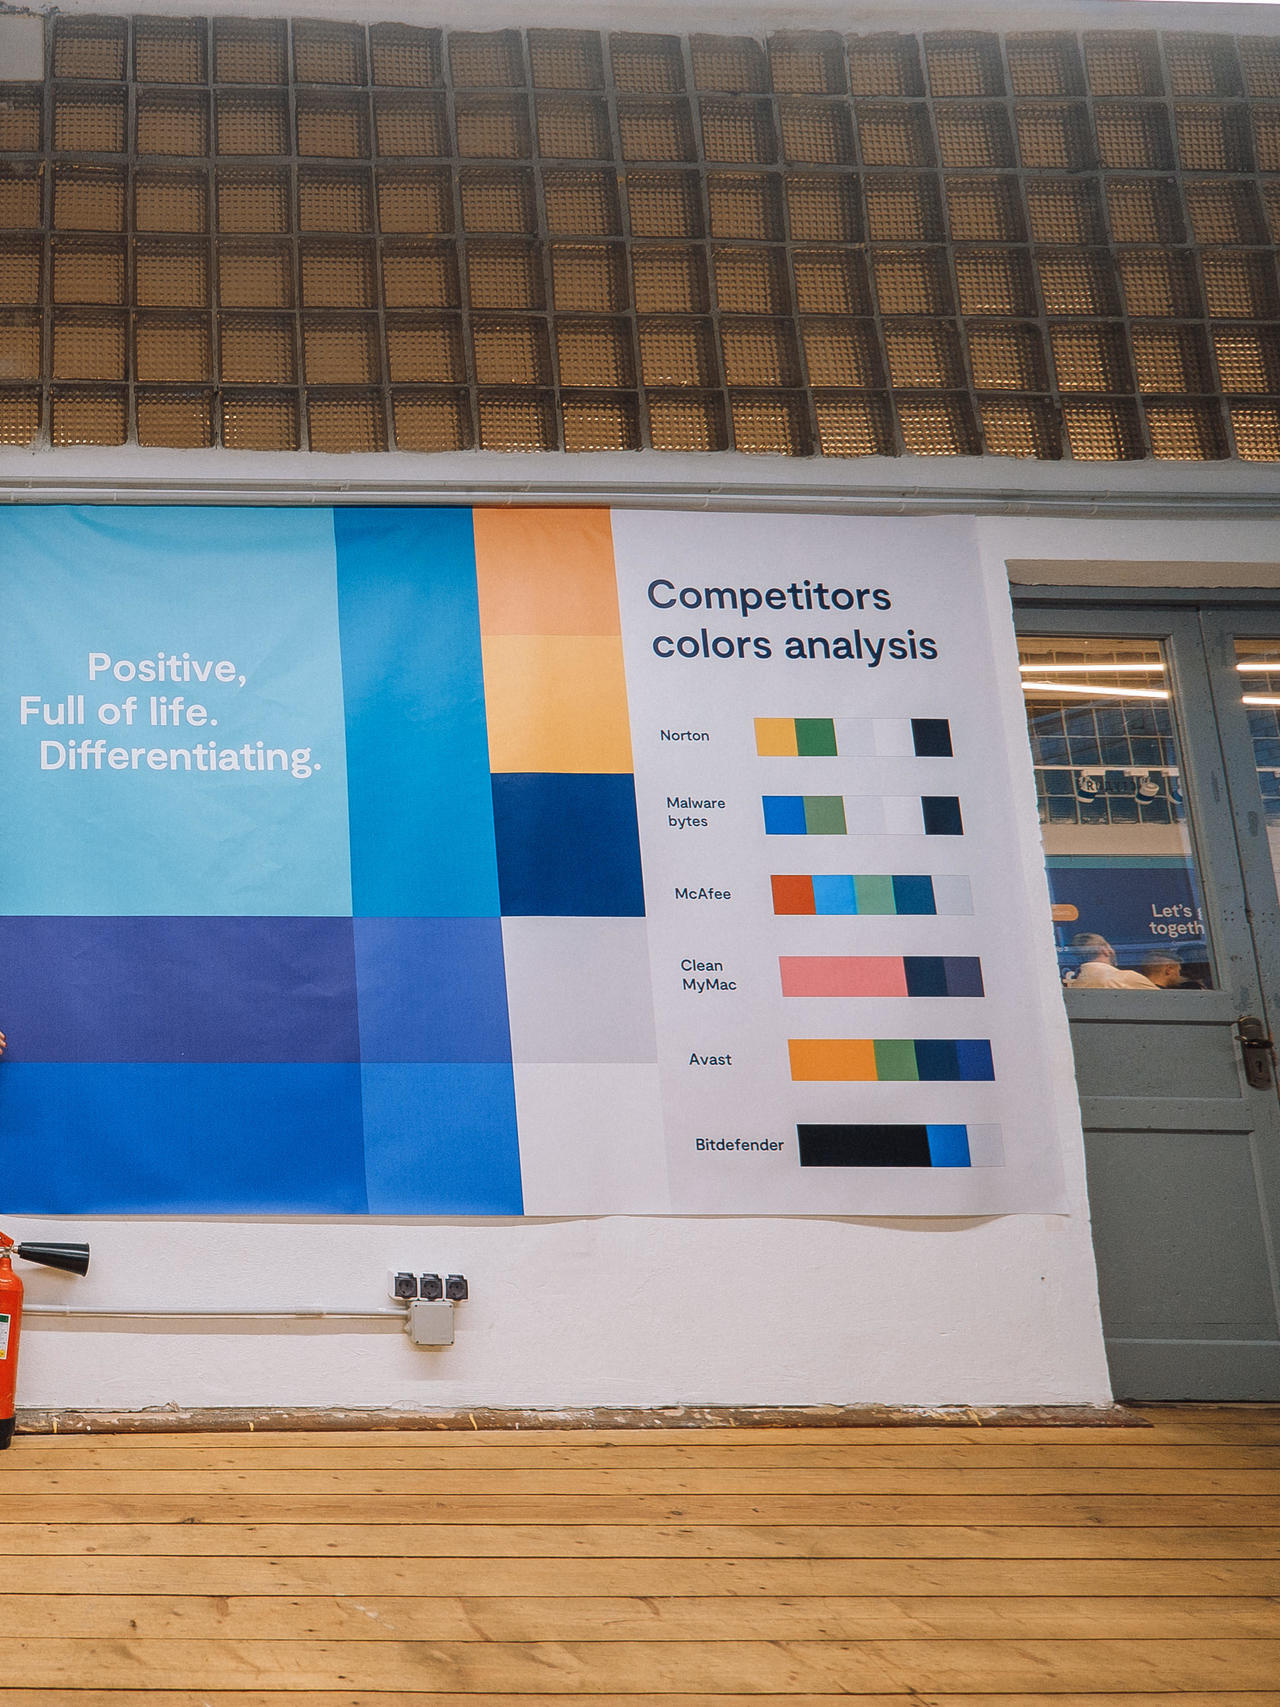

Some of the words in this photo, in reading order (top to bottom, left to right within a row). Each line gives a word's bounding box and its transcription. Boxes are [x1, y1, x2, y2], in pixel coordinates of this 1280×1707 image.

[647, 579, 892, 618] Competitors
[652, 627, 772, 659] colors
[784, 628, 938, 668] analysis
[88, 652, 247, 687] Positive,
[20, 695, 85, 725] Full
[97, 696, 138, 725] of
[150, 696, 218, 727] life.
[660, 729, 710, 742] Norton
[40, 739, 321, 779] Differentiating.
[666, 797, 726, 809] Malware
[668, 815, 708, 829] bytes
[675, 888, 731, 900] McAfee
[680, 959, 723, 972] Clean
[682, 978, 737, 993] MyMac
[689, 1053, 732, 1065] Avast
[696, 1138, 785, 1151] Bitdefender
